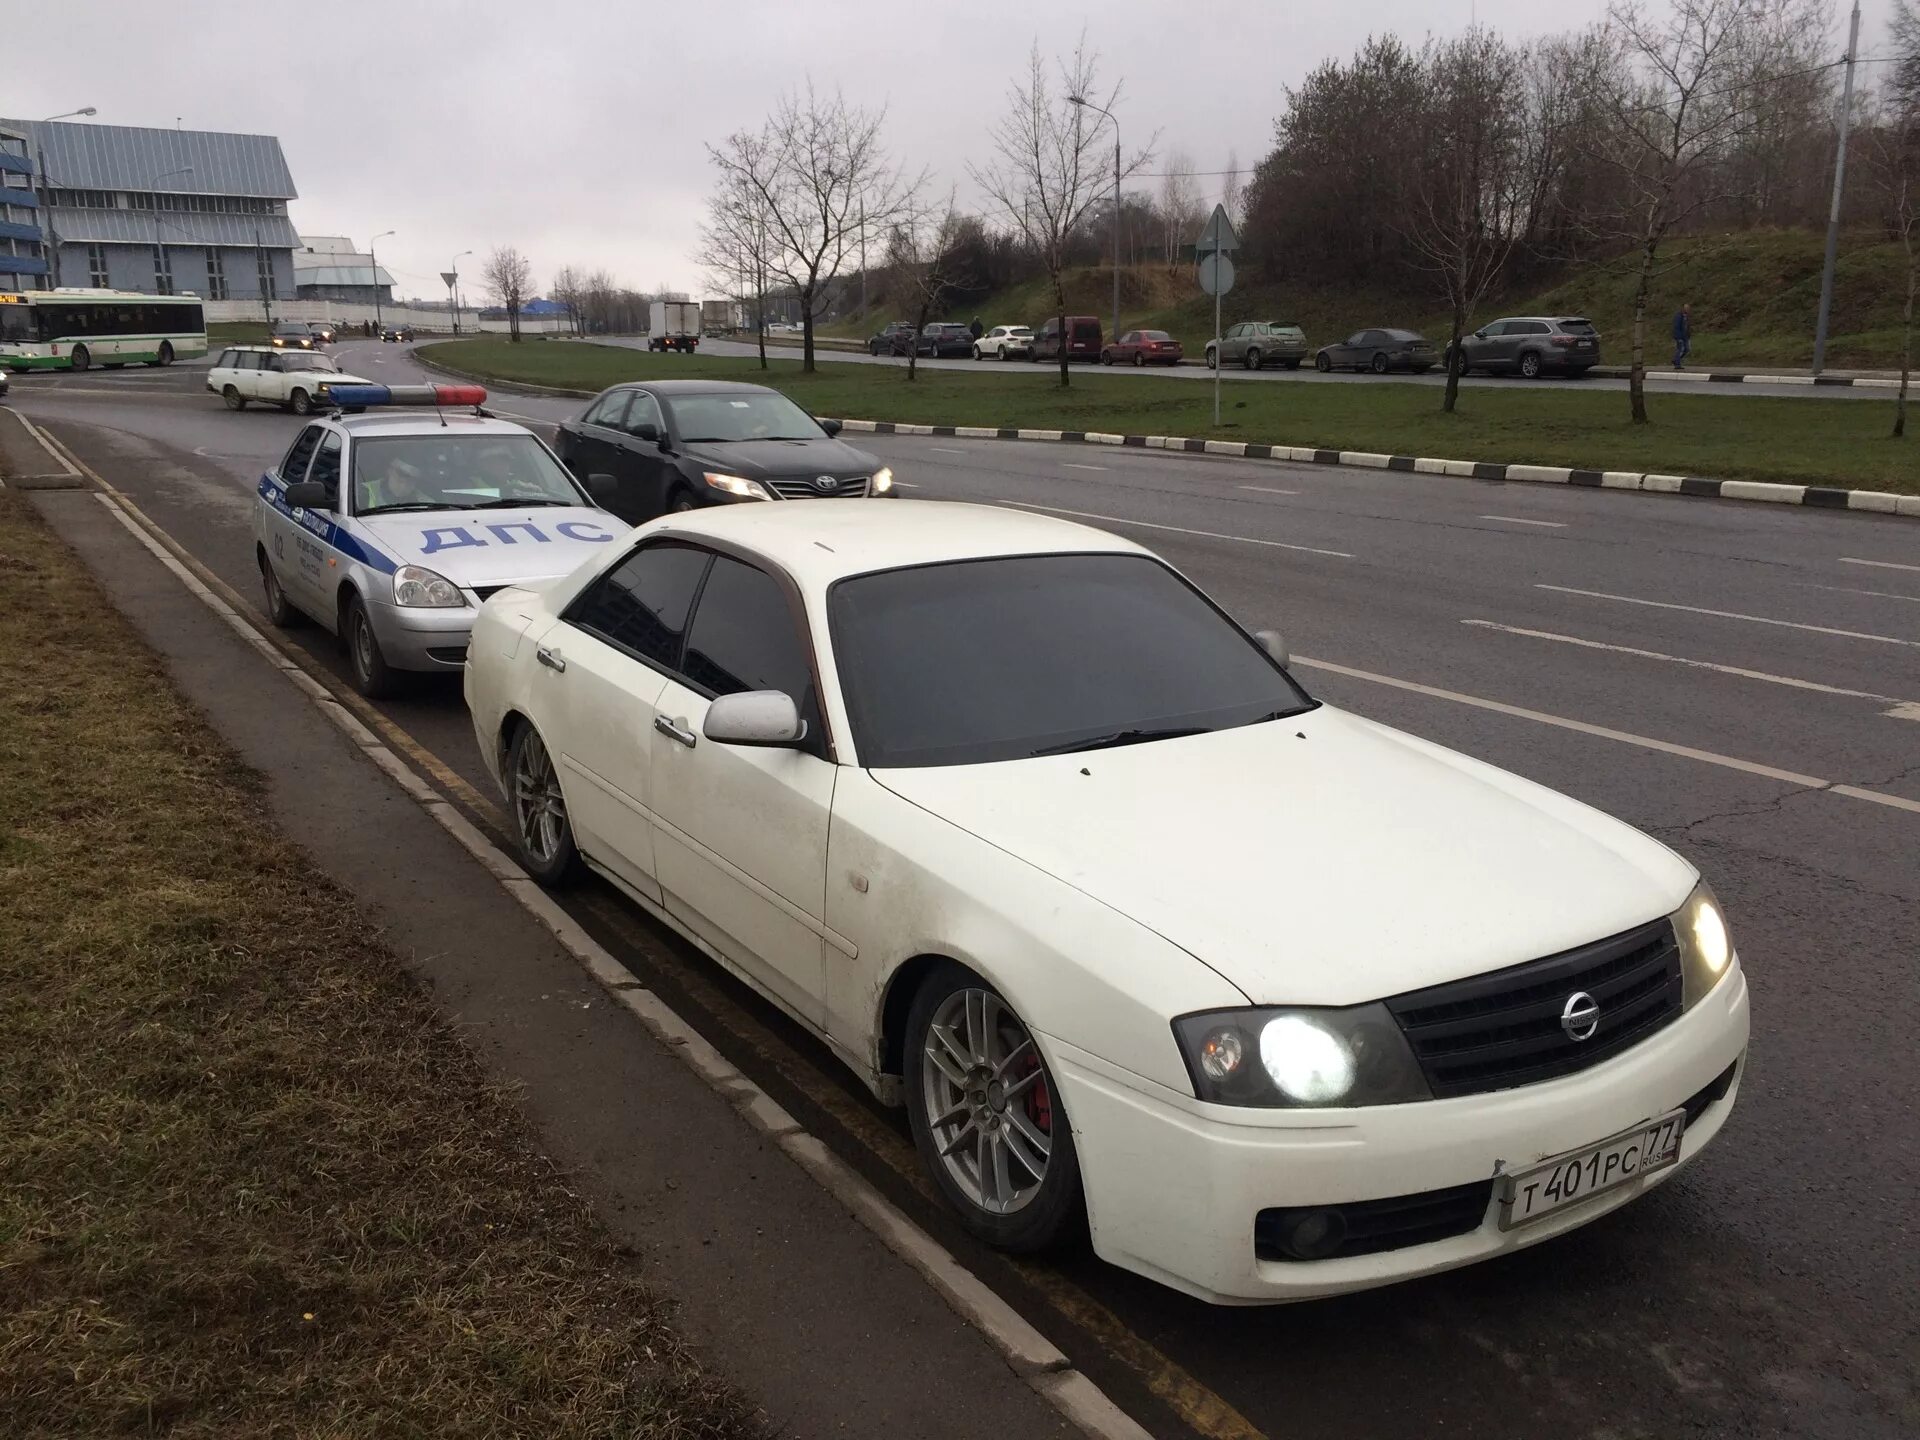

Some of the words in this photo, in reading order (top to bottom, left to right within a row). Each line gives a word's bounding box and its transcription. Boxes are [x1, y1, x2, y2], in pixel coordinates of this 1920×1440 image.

[420, 522, 614, 554] ДПС
[1648, 1123, 1674, 1155] 77
[1642, 1152, 1661, 1168] RUS
